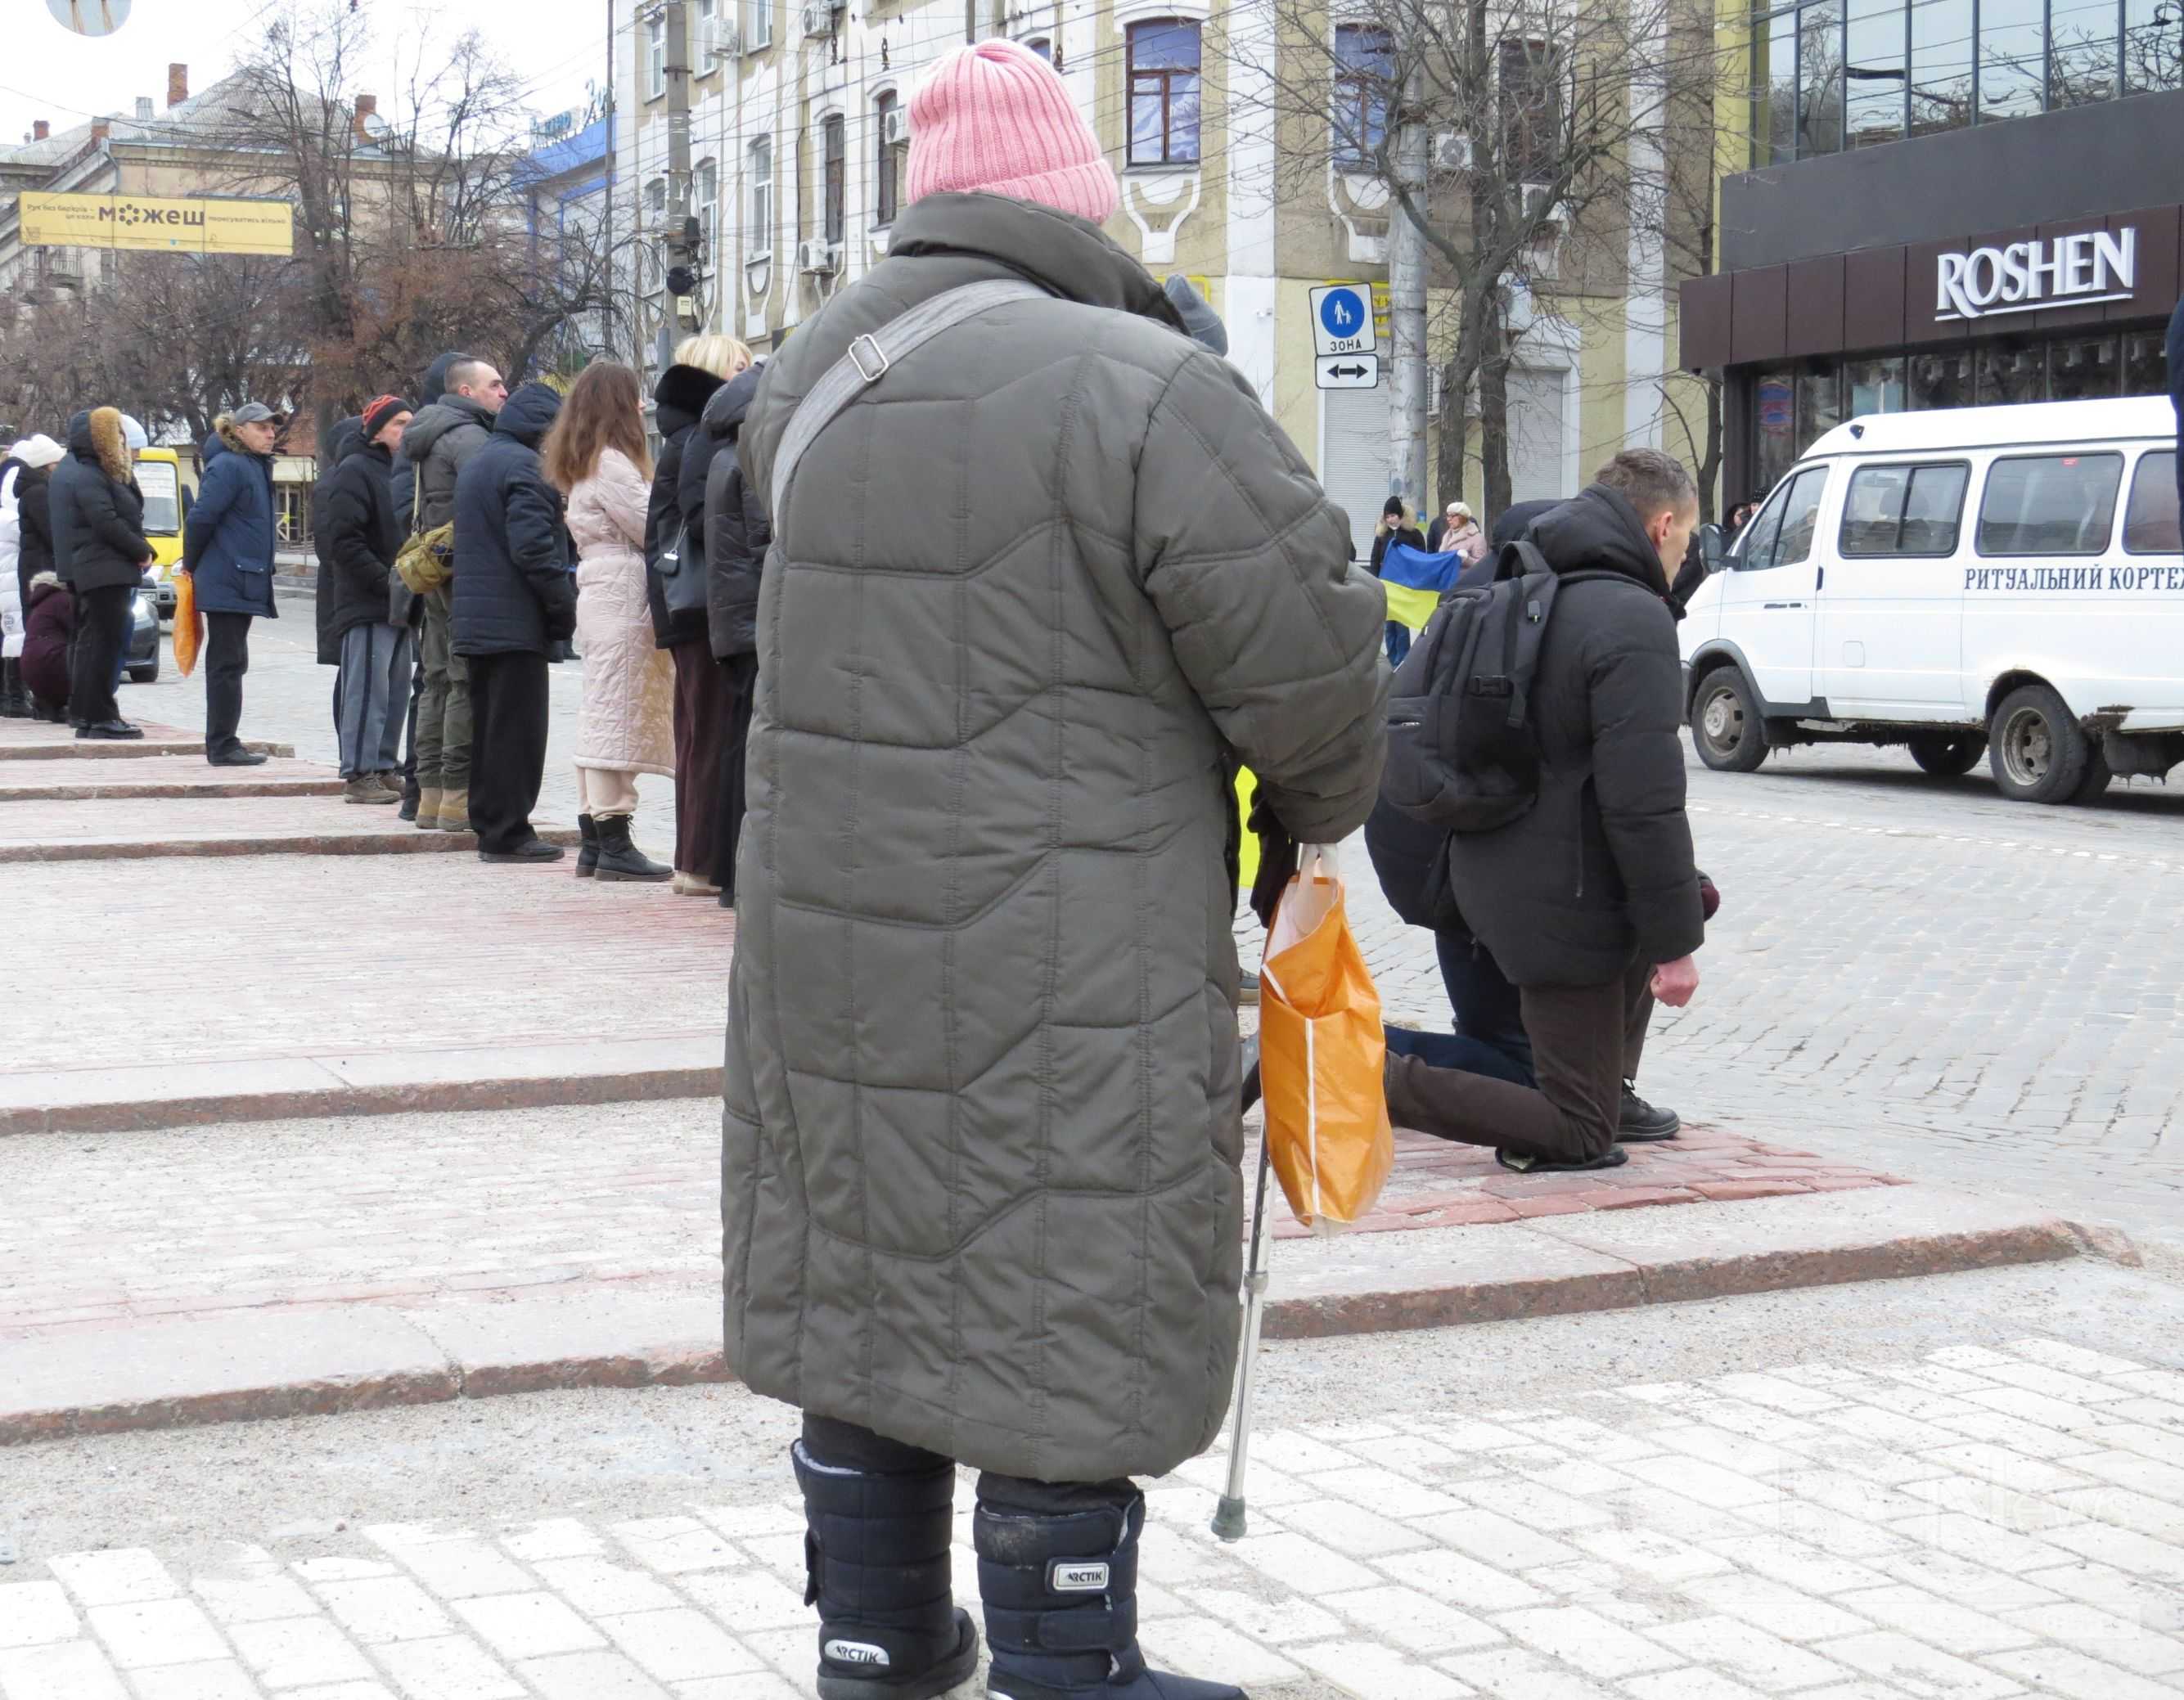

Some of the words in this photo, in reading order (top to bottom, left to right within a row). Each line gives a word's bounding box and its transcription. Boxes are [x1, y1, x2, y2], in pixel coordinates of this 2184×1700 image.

[1936, 227, 2135, 318] ROSHEN
[1330, 339, 1362, 352] ЗОНА
[1964, 564, 2103, 590] РИТУАЛЬНИЙ
